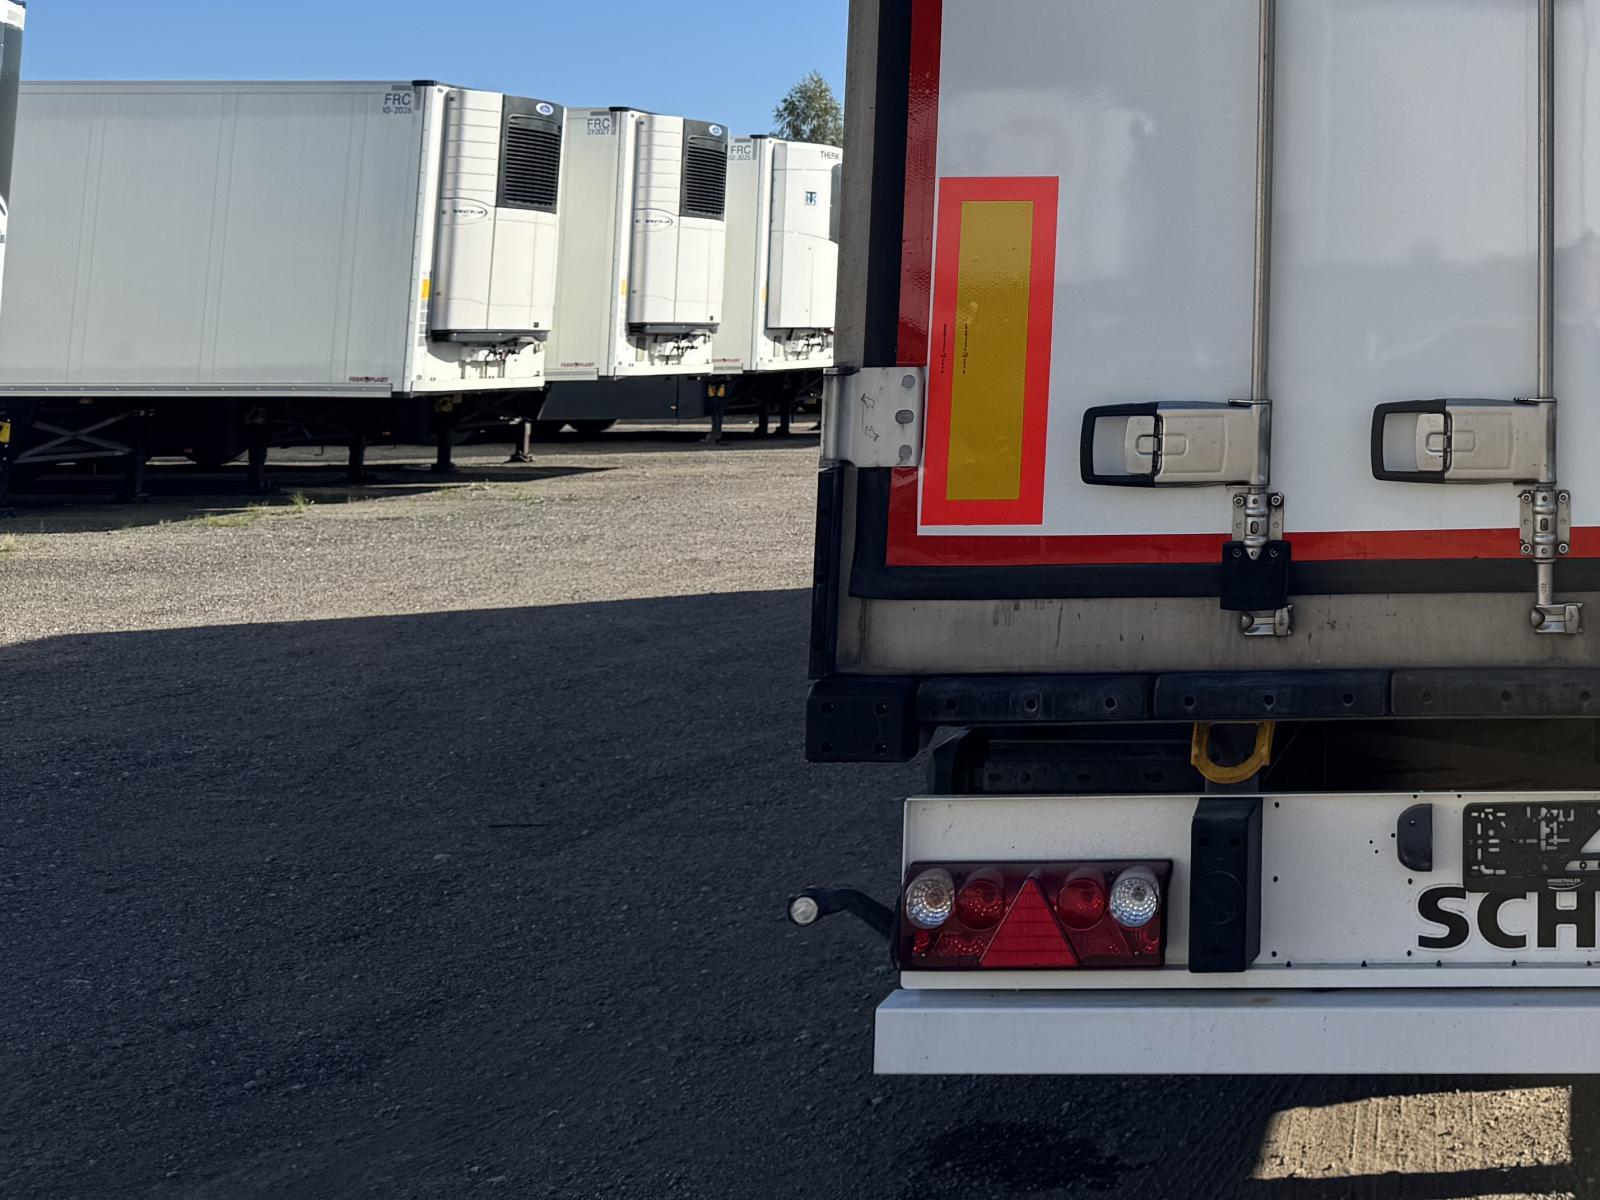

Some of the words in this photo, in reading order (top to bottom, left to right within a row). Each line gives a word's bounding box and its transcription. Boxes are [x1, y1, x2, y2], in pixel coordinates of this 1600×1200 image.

[384, 93, 411, 106] FRC
[587, 118, 610, 129] FRC
[730, 145, 751, 155] FRC
[820, 150, 840, 160] THERM
